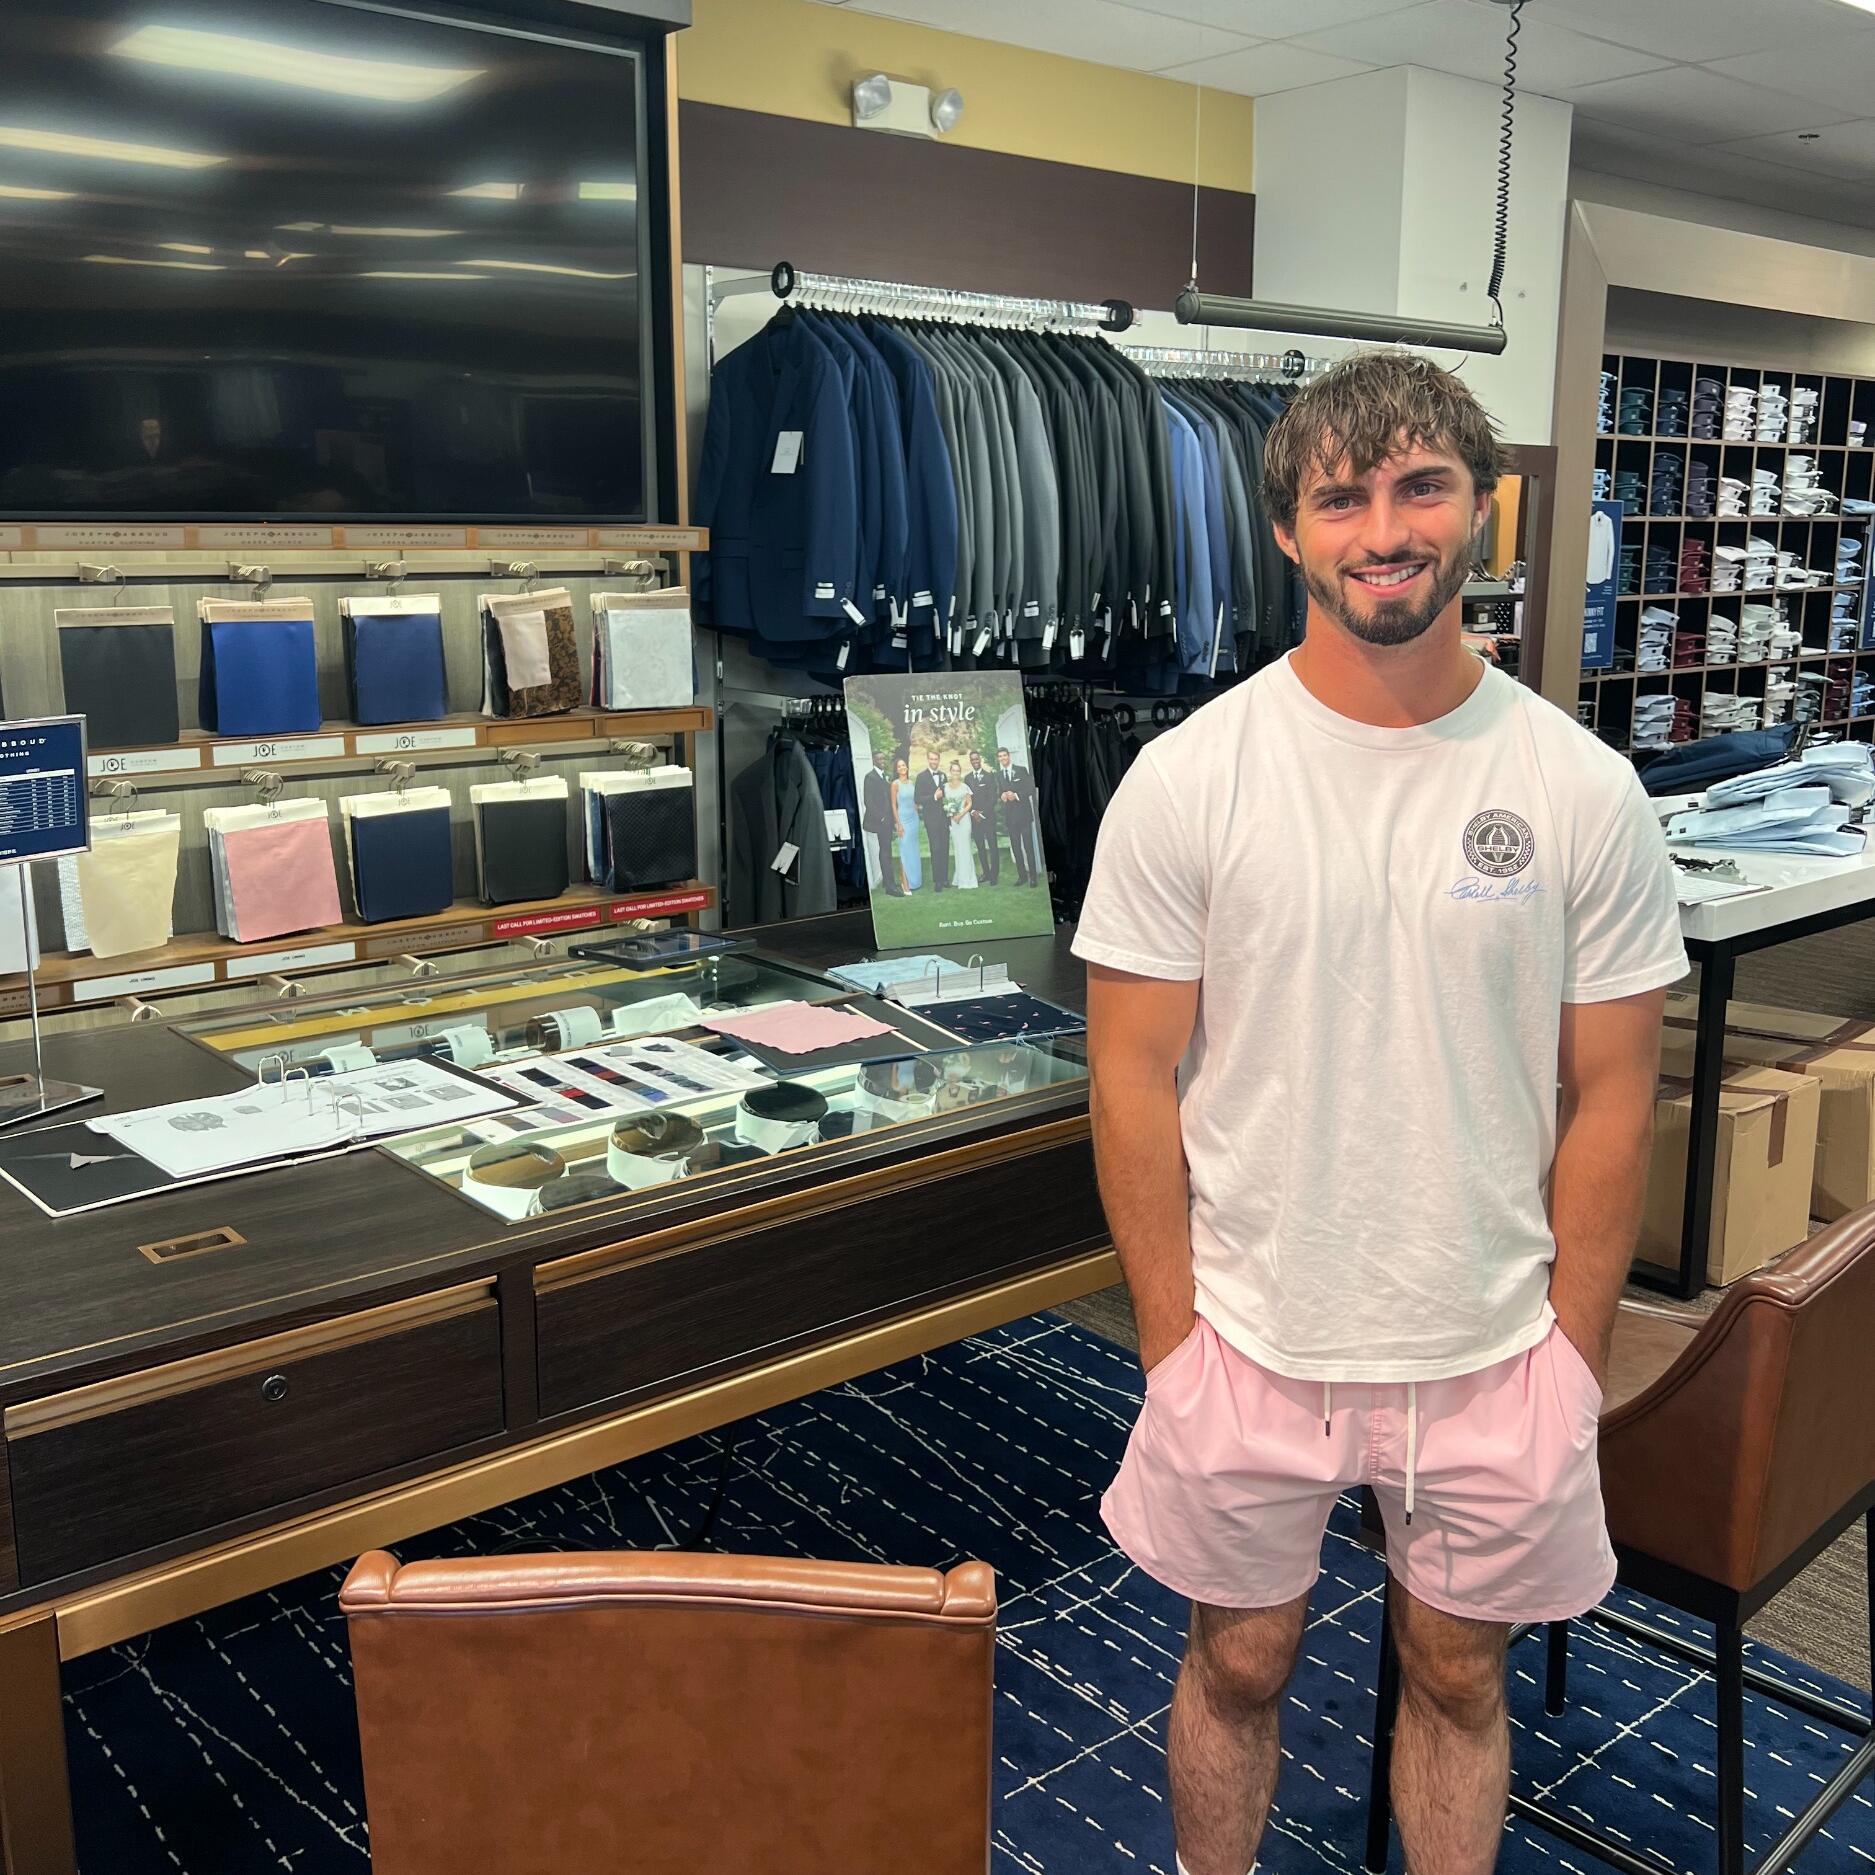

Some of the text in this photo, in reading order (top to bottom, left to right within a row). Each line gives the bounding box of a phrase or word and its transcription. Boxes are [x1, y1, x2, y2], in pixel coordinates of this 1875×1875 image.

[903, 701, 976, 727] in style
[253, 744, 278, 757] JOE
[395, 736, 416, 749] JOE
[100, 758, 127, 772] JOE
[1492, 812, 1530, 839] AMERICAN
[497, 922, 510, 930] LAST
[533, 914, 571, 926] LIMITED-EDITION
[571, 911, 597, 920] SWATCHES
